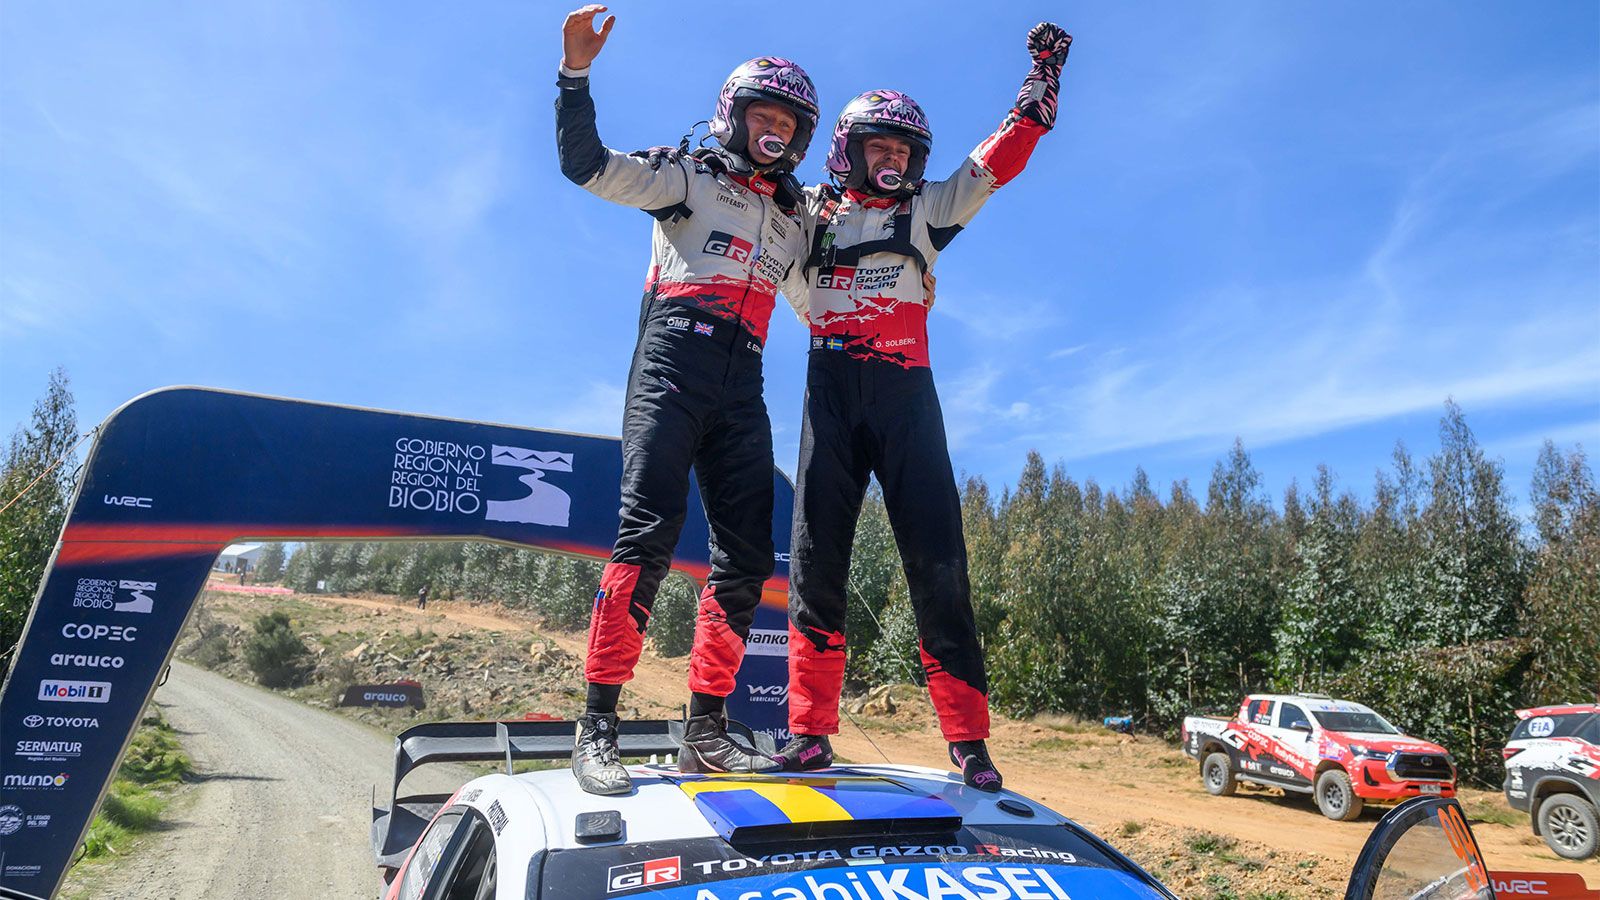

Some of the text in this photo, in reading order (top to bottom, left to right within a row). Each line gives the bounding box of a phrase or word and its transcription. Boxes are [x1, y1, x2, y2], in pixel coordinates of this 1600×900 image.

[704, 240, 748, 264] GR
[857, 264, 905, 276] TOYOTA
[817, 274, 852, 291] GR
[856, 273, 900, 284] GAZOO
[855, 280, 897, 291] Racing
[667, 318, 690, 328] OMP
[885, 338, 916, 348] SOLBERG
[395, 437, 486, 460] GOBIERNO
[394, 453, 483, 477] REGIONAL
[391, 470, 481, 492] REGION DEL
[104, 494, 153, 508] WRC
[388, 486, 481, 514] BIOBIO
[773, 551, 791, 562] RC
[77, 577, 118, 588] GOBIERNO
[76, 585, 116, 594] REGIONAL
[75, 592, 100, 600] REGION
[73, 599, 114, 610] BIOBIO
[62, 623, 138, 642] COPEC
[747, 633, 789, 645] hanko
[50, 653, 125, 669] arauco
[43, 684, 86, 698] Mobil
[363, 690, 407, 702] arauco
[46, 716, 99, 728] TOYOTA
[16, 740, 82, 752] SERNATUR
[1270, 766, 1295, 778] arauco
[693, 844, 1077, 876] TOYOTA GAZOO Racing
[610, 866, 679, 891] GR
[1491, 879, 1549, 895] WRC
